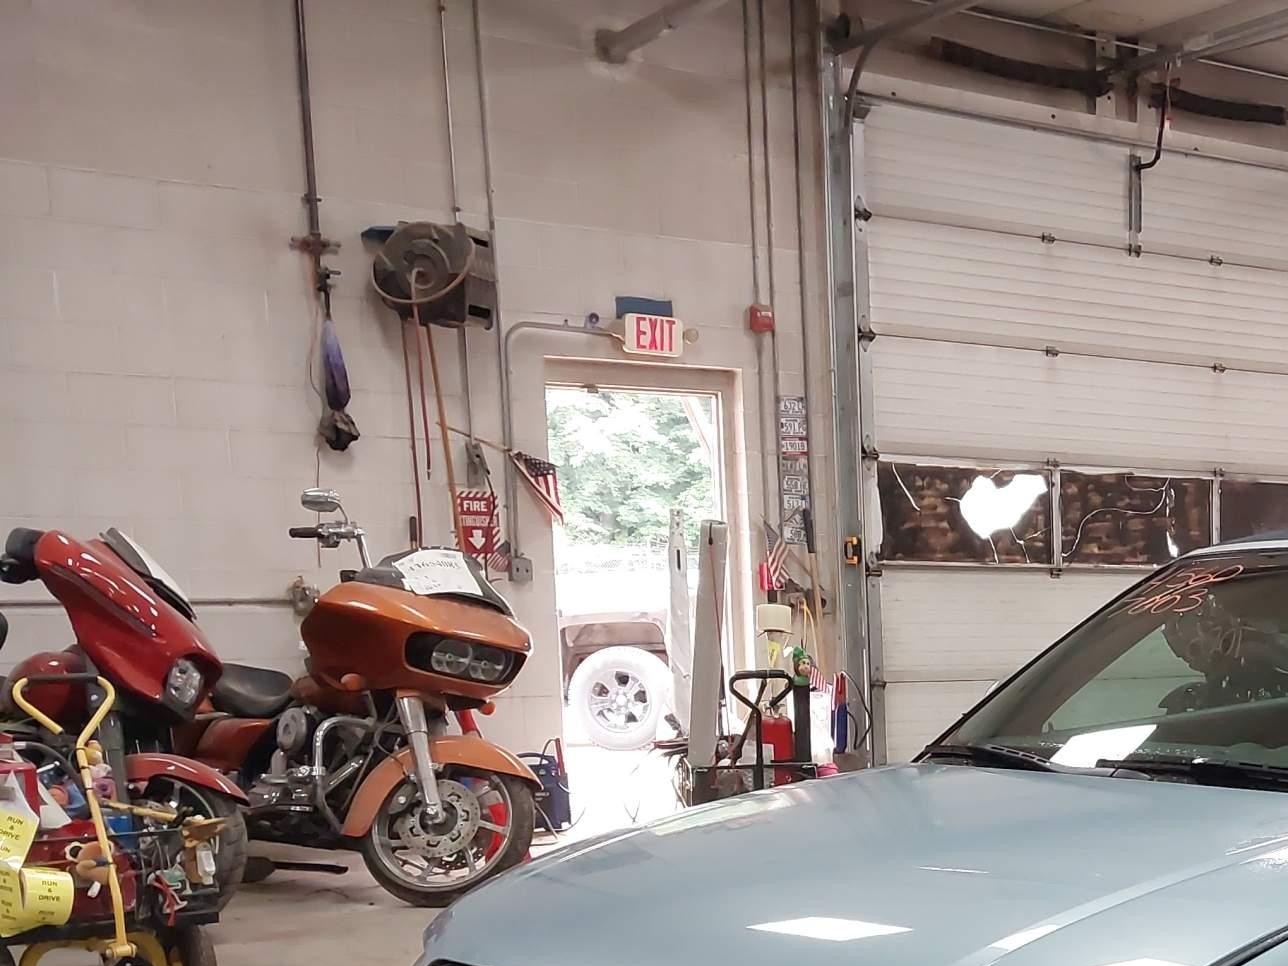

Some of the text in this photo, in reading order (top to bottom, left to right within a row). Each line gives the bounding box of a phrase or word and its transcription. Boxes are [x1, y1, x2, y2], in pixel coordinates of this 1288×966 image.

[635, 316, 676, 352] EXIT
[463, 500, 488, 512] FIRE
[7, 816, 24, 825] RUN
